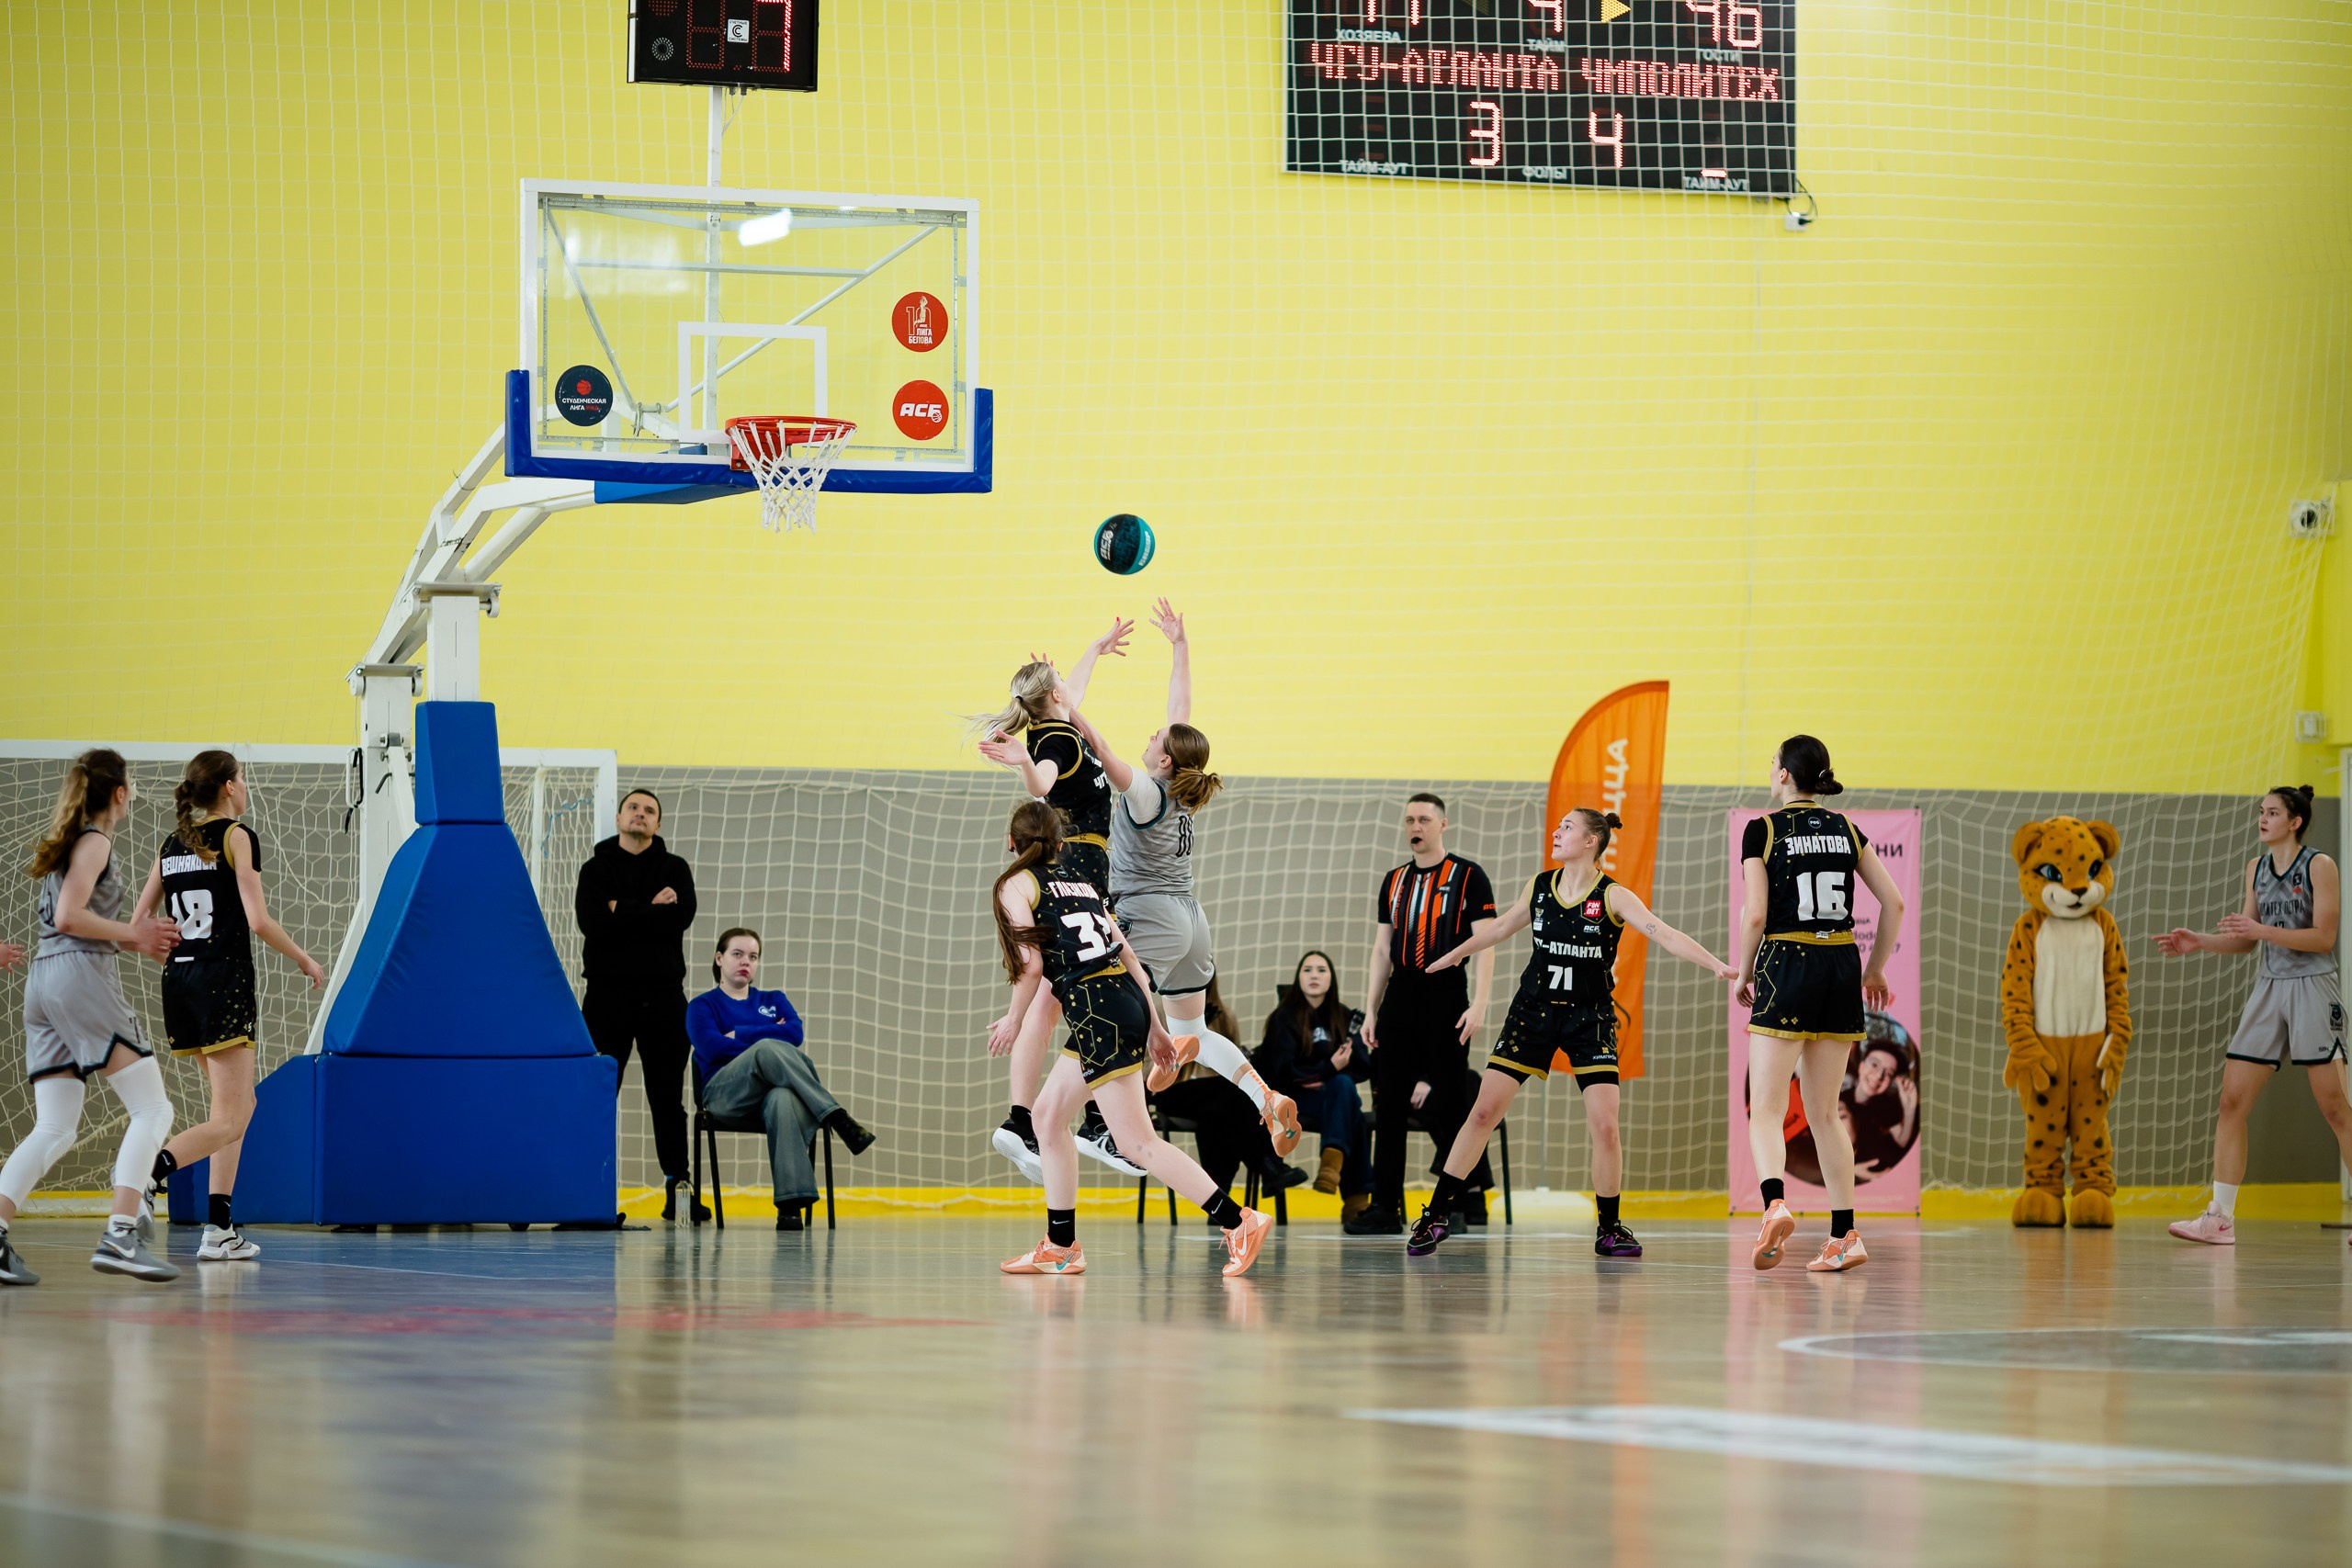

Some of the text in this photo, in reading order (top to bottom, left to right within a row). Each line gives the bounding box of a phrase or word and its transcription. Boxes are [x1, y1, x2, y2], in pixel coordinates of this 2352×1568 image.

[1336, 28, 1402, 43] ХОЗЯЕВА
[1526, 37, 1566, 53] ТАЙМ
[1696, 49, 1741, 62] ГОСТИ
[1311, 42, 1559, 91] ЧГУ-АТЛАНТА
[1470, 101, 1501, 166] 3
[1588, 111, 1623, 168] 4
[1339, 158, 1409, 175] ТАЙМ-АУТ
[1521, 165, 1567, 181] ФОЛЫ
[908, 335, 933, 344] БЕЛОВА
[916, 328, 933, 336] ЛИГА
[899, 402, 943, 423] АСБ
[1602, 738, 1630, 871] ПЦЦА
[1785, 835, 1851, 856] ЗИНАТОВА
[1796, 871, 1849, 921] 16
[170, 888, 213, 941] 18
[1547, 964, 1573, 991] 71
